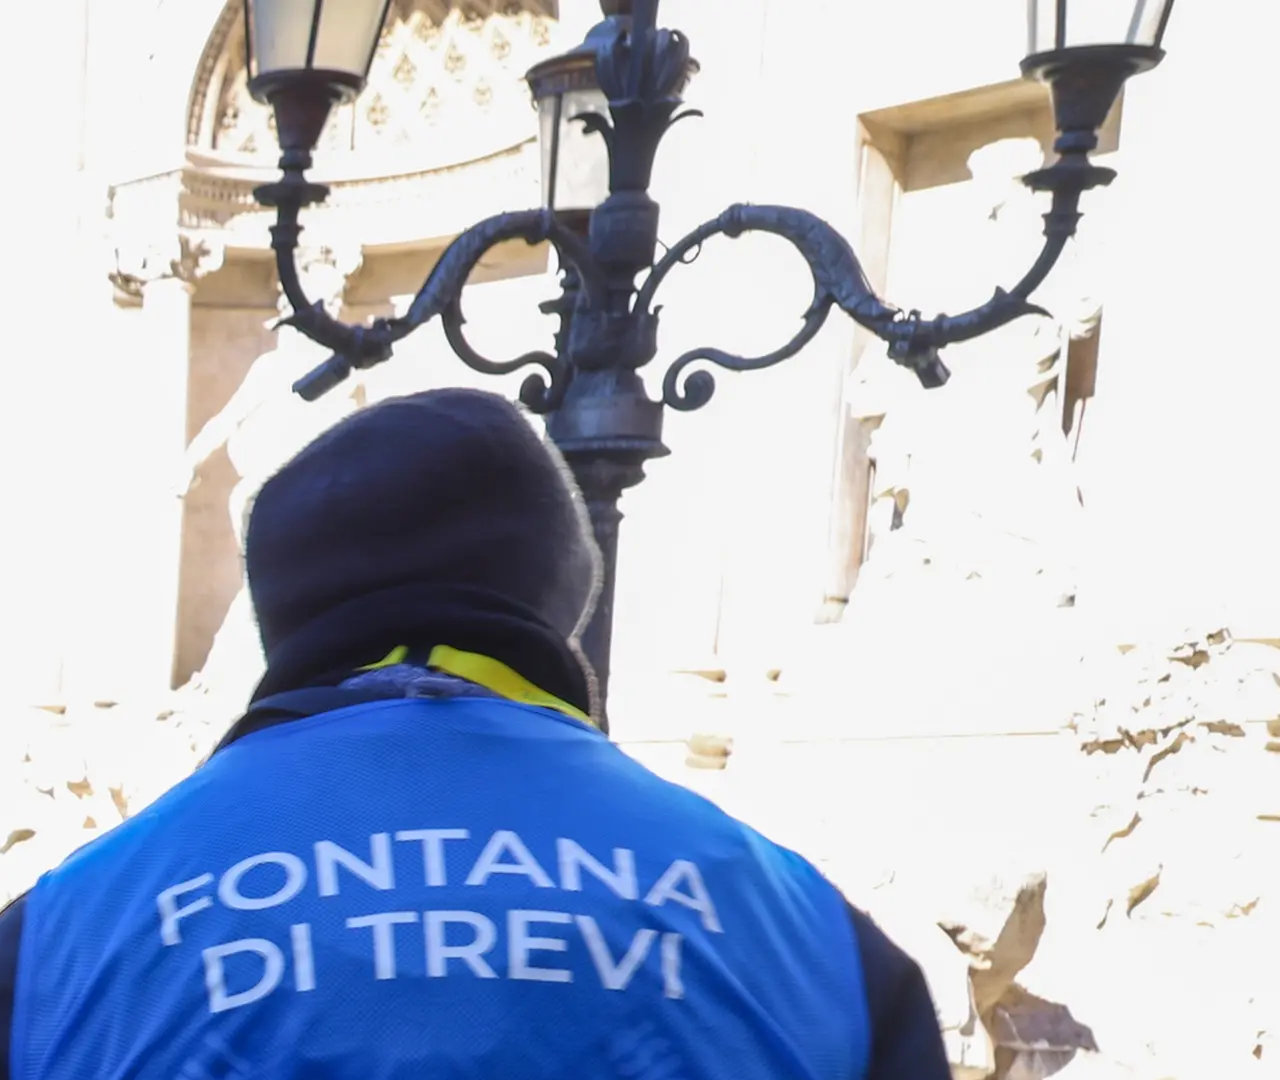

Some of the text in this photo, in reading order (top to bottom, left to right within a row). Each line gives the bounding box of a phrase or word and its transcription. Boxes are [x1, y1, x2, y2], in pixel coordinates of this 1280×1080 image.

[156, 827, 724, 946] FONTANA
[202, 909, 685, 1015] DI TREVI
